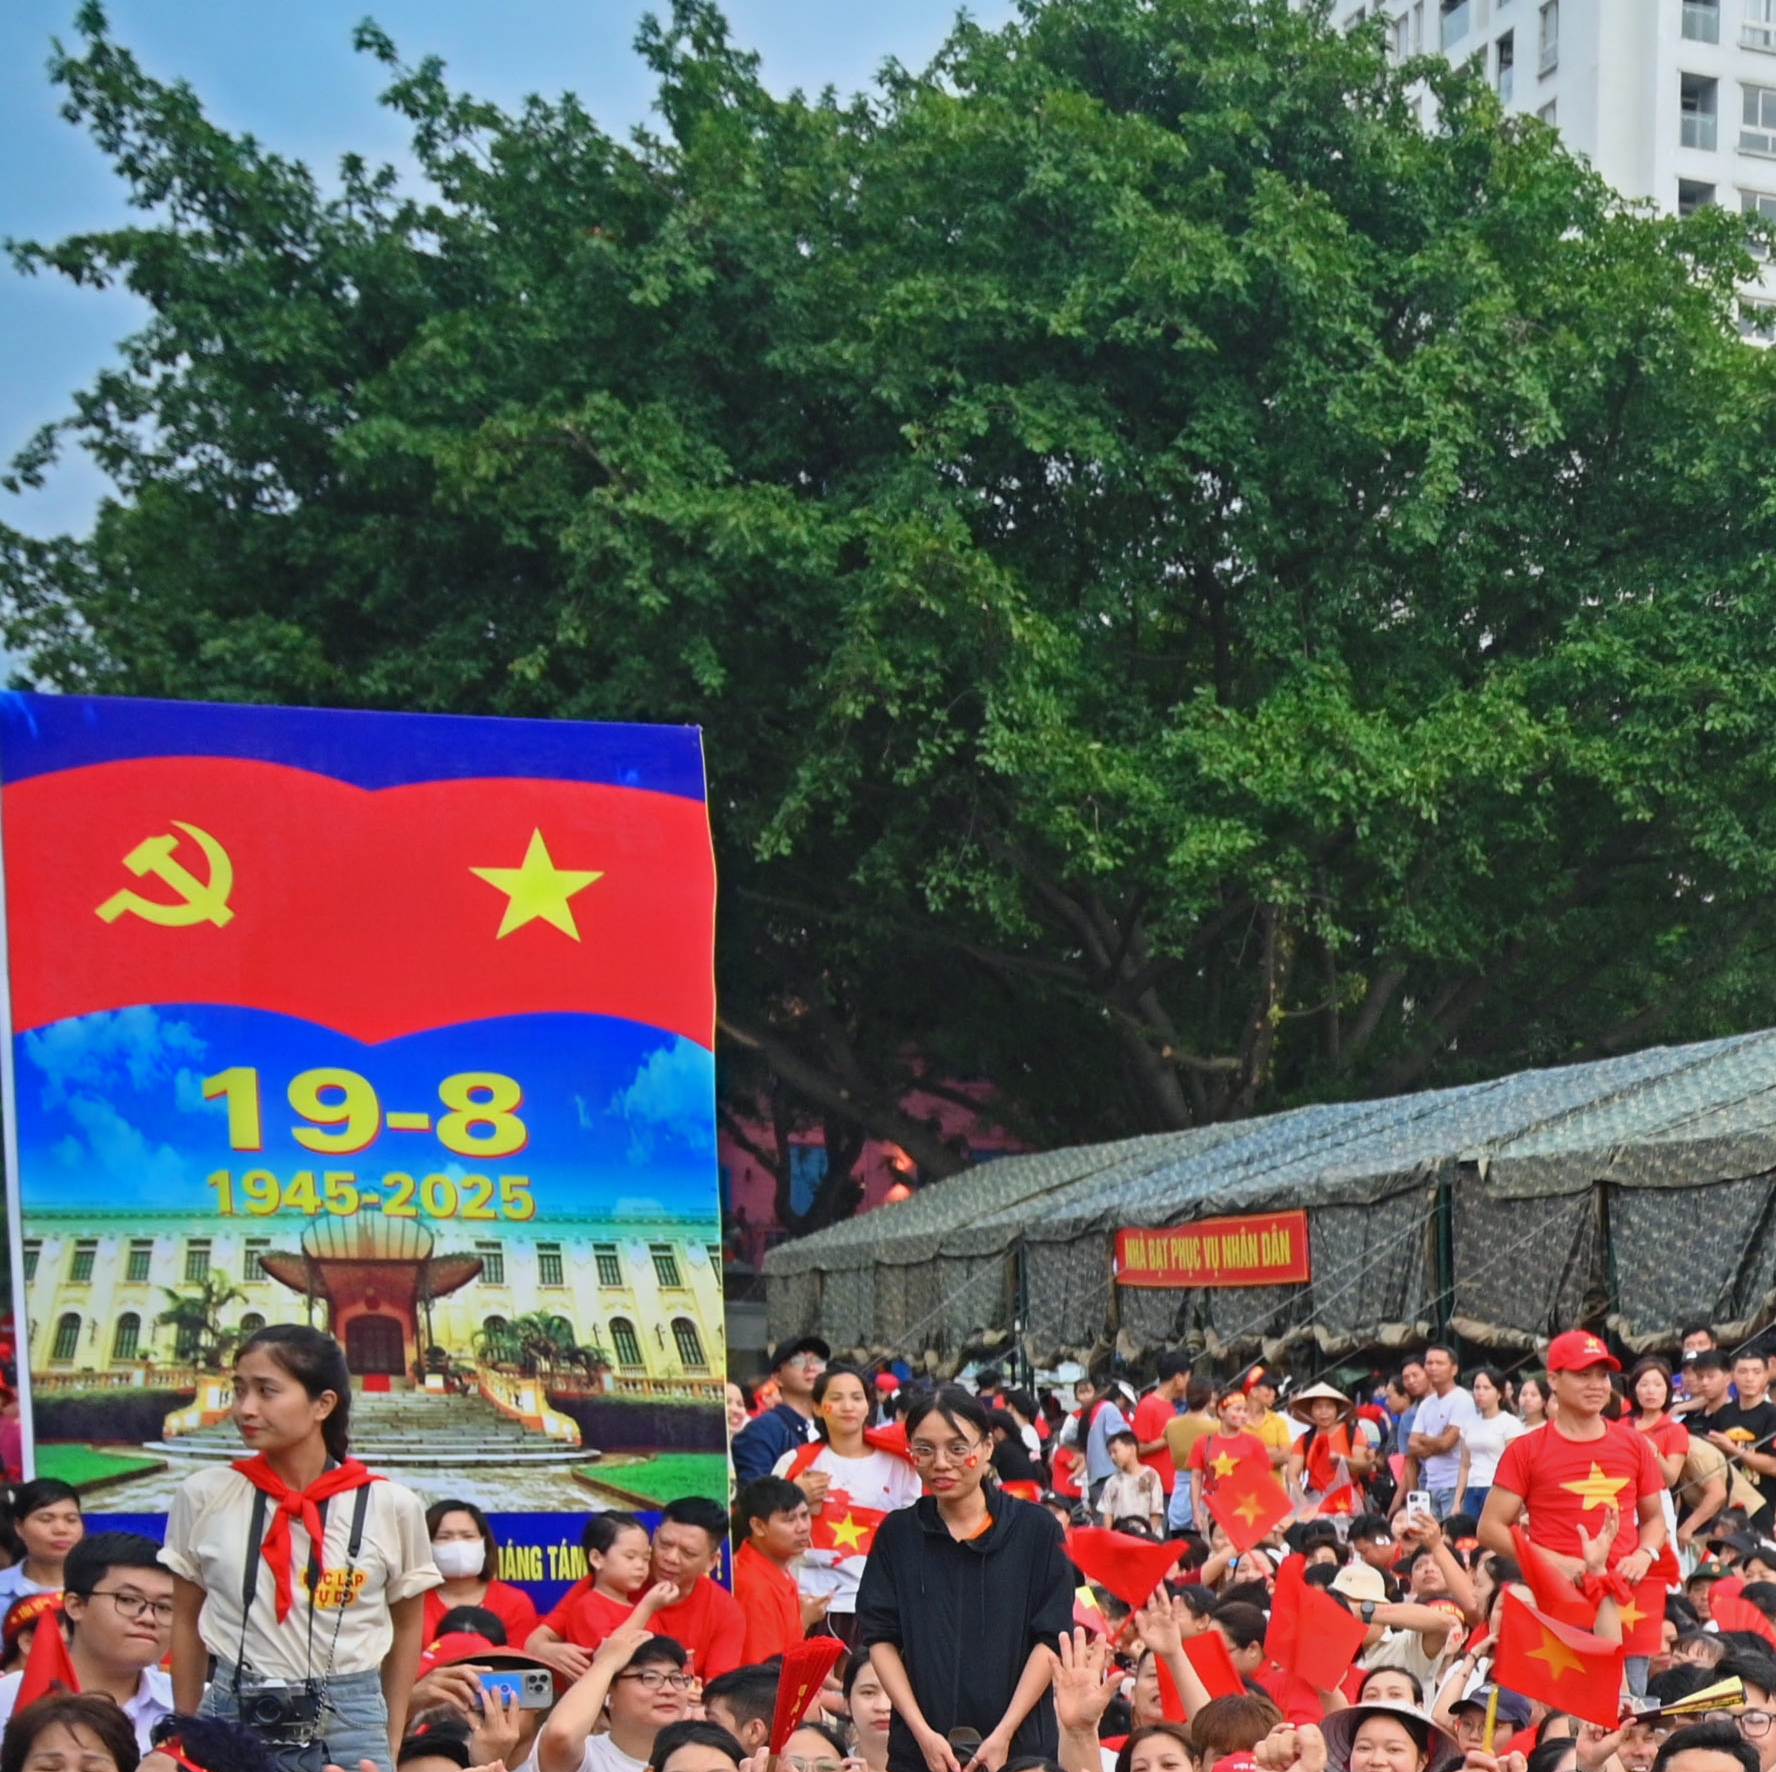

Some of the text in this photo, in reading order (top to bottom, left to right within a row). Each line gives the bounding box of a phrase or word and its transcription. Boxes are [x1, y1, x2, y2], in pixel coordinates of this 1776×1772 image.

[202, 1067, 529, 1158] 19-8
[205, 1168, 537, 1222] 1945-2025
[1124, 1222, 1290, 1278] NHÀ BẠT PHỤC VỤ NHÂN DÂN
[547, 1538, 589, 1581] TÁM
